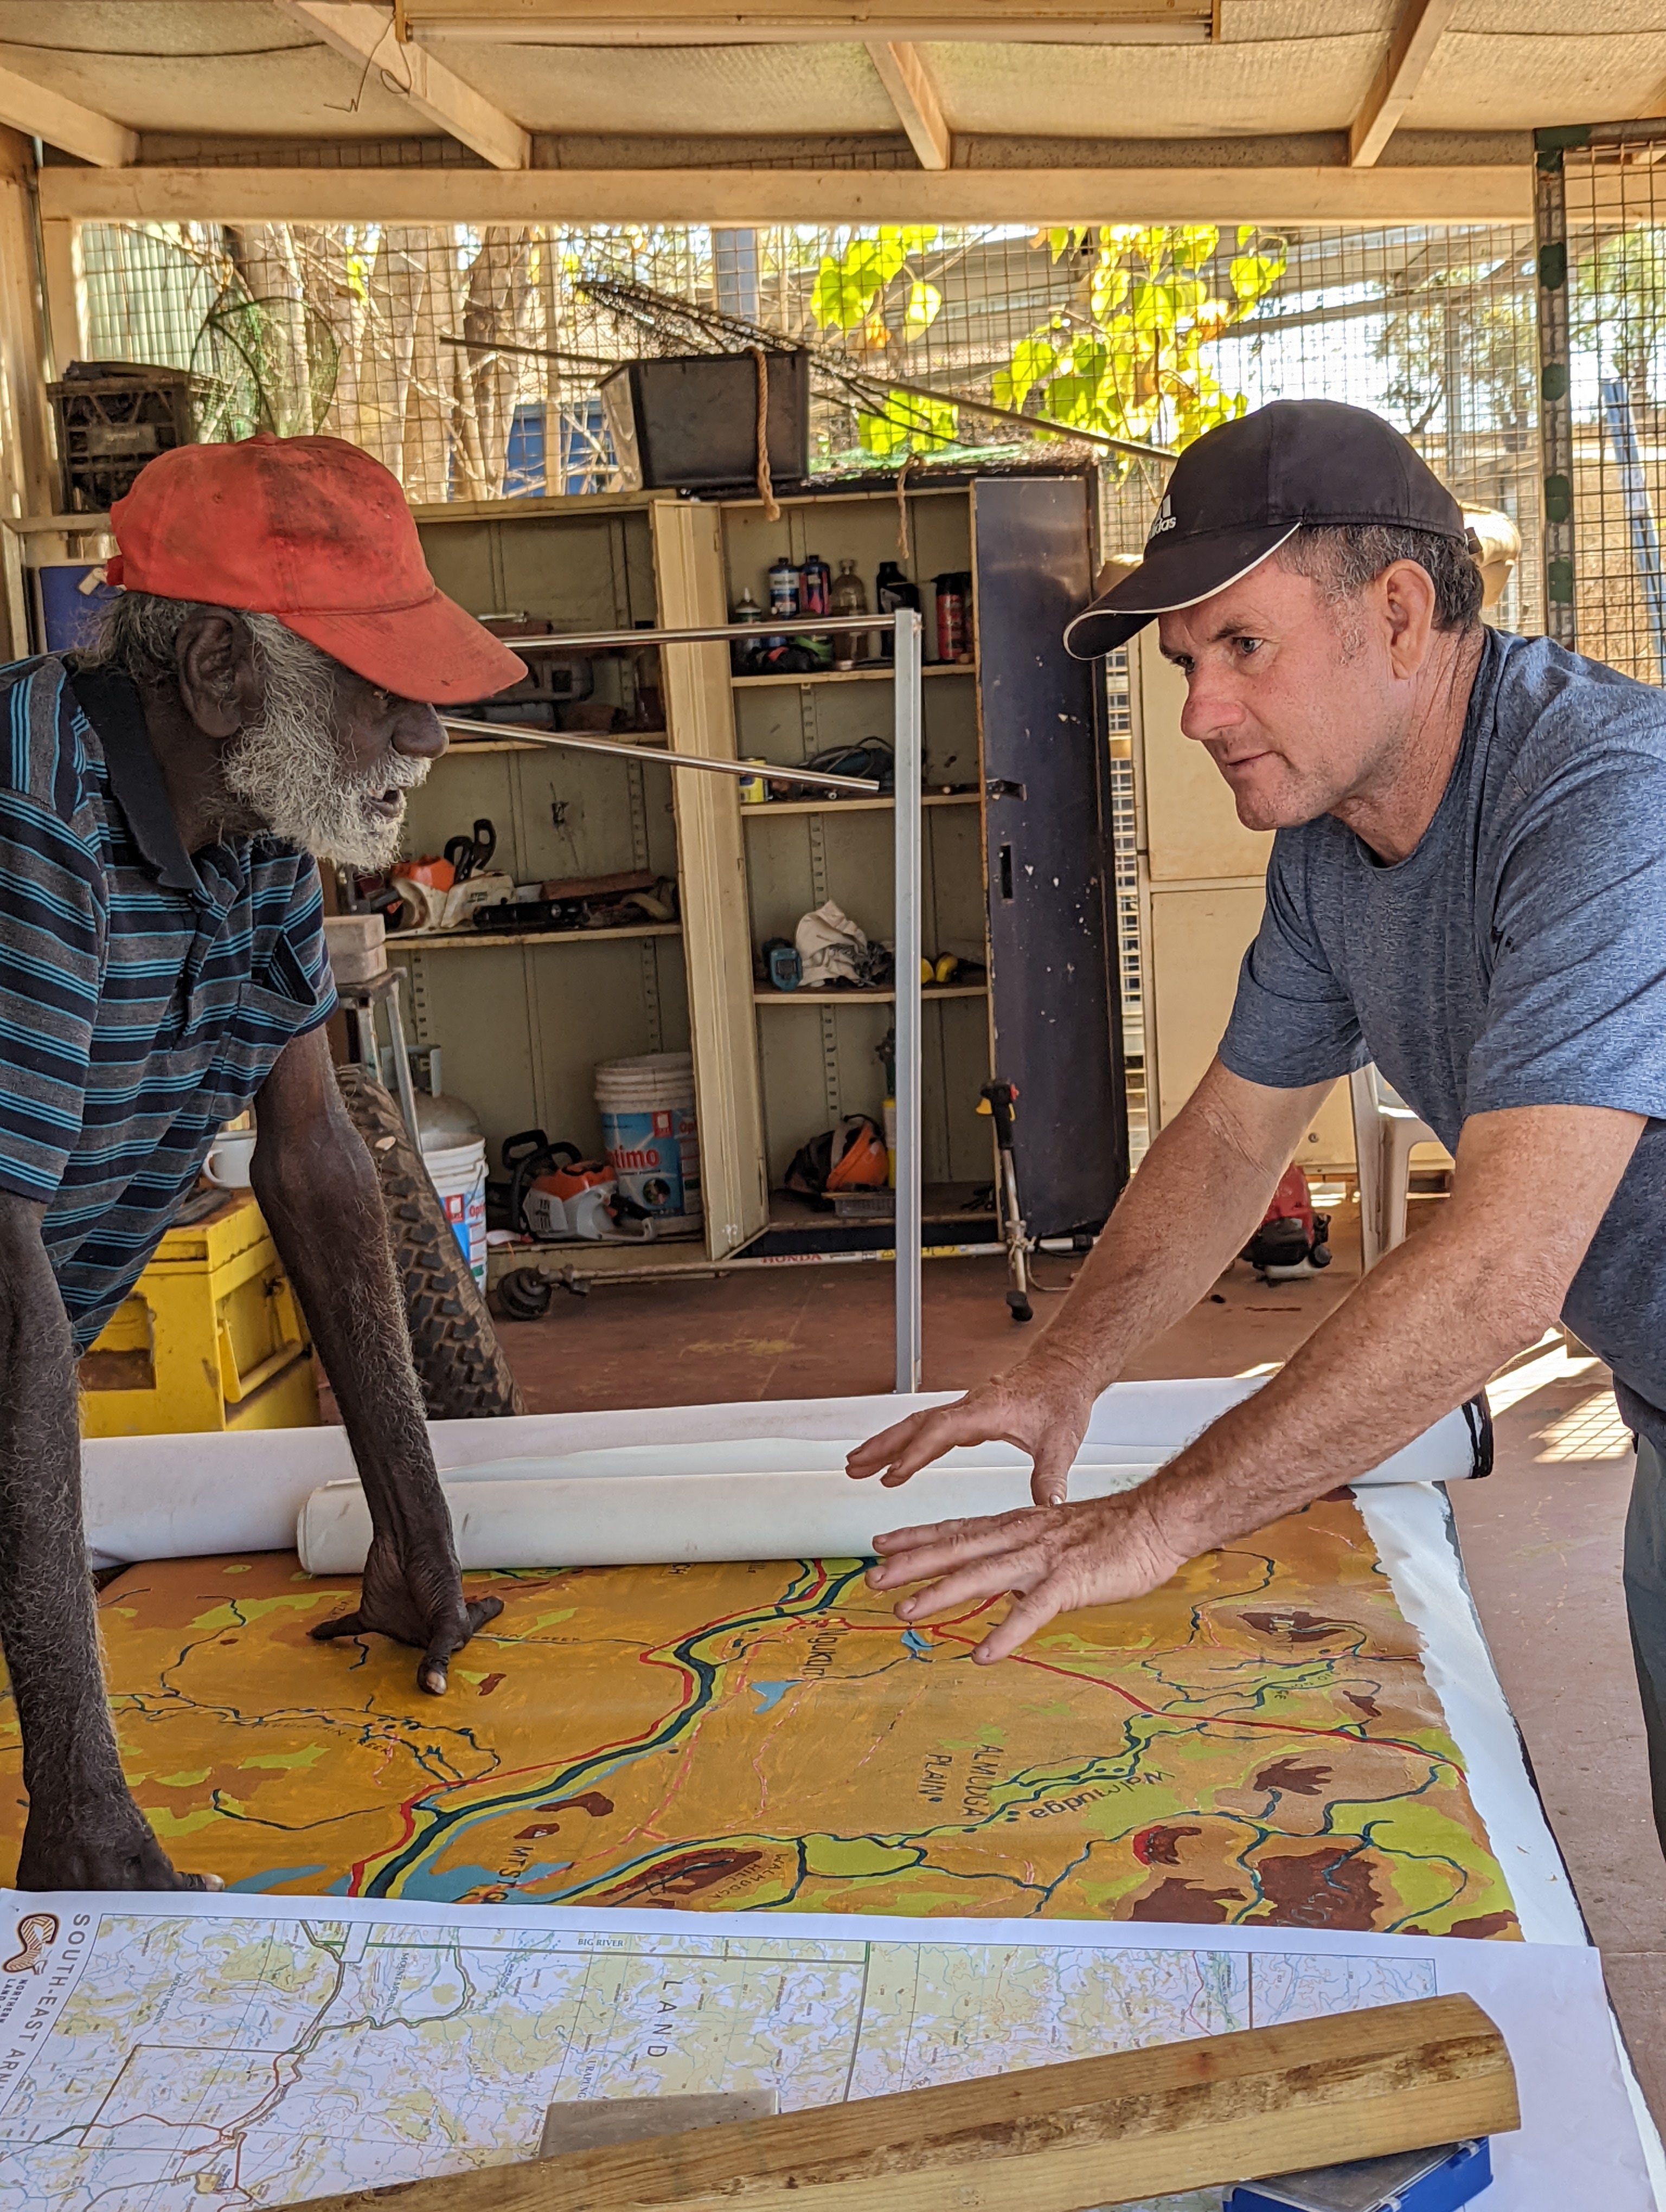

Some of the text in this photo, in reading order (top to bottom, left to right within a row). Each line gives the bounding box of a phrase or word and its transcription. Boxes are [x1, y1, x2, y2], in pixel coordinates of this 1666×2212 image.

[761, 1253, 822, 1264] HONDA
[919, 1754, 953, 1796] PLAIN
[578, 1938, 624, 1947] BIG RIVER
[18, 1913, 91, 2042] SOUTH-EAST
[394, 1952, 409, 1982] MOUNT
[164, 1972, 184, 1998] MOUNT
[646, 1980, 683, 2058] LAND
